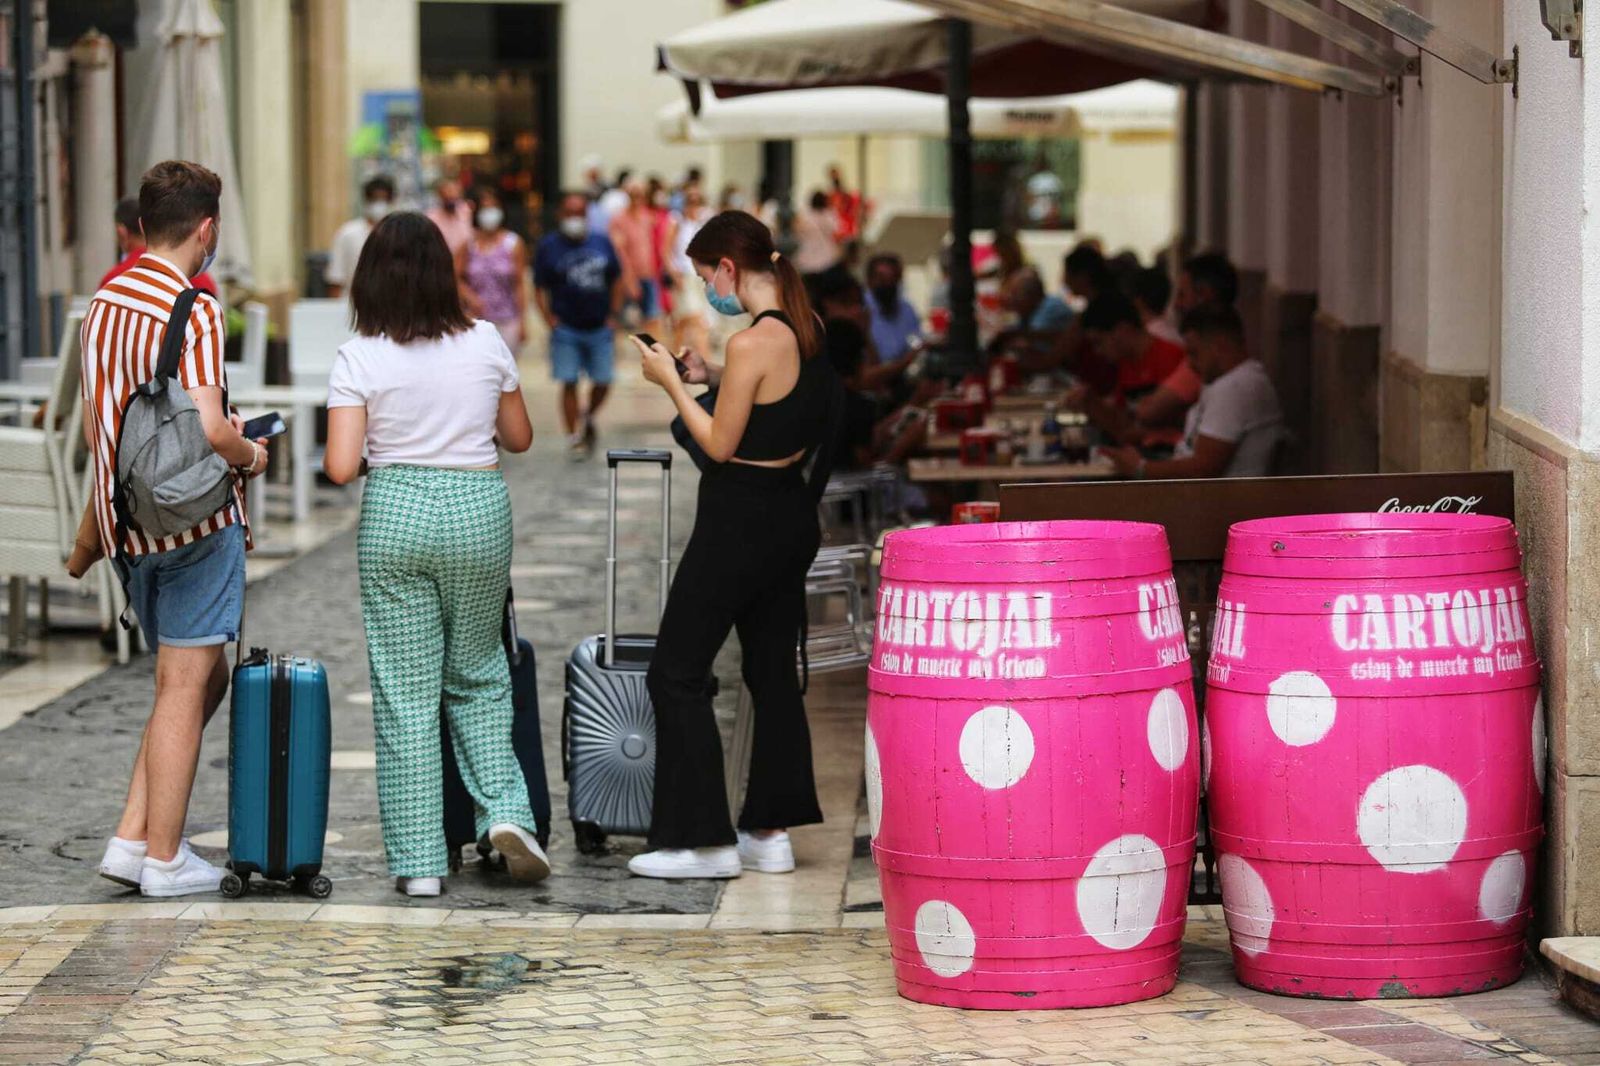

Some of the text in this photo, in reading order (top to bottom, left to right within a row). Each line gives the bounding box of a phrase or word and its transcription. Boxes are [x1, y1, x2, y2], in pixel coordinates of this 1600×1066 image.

[1377, 496, 1483, 515] Coca-Cl
[878, 586, 1060, 656] CARTOJAL
[1331, 586, 1526, 653] CARTOJAL
[1395, 654, 1413, 678] de
